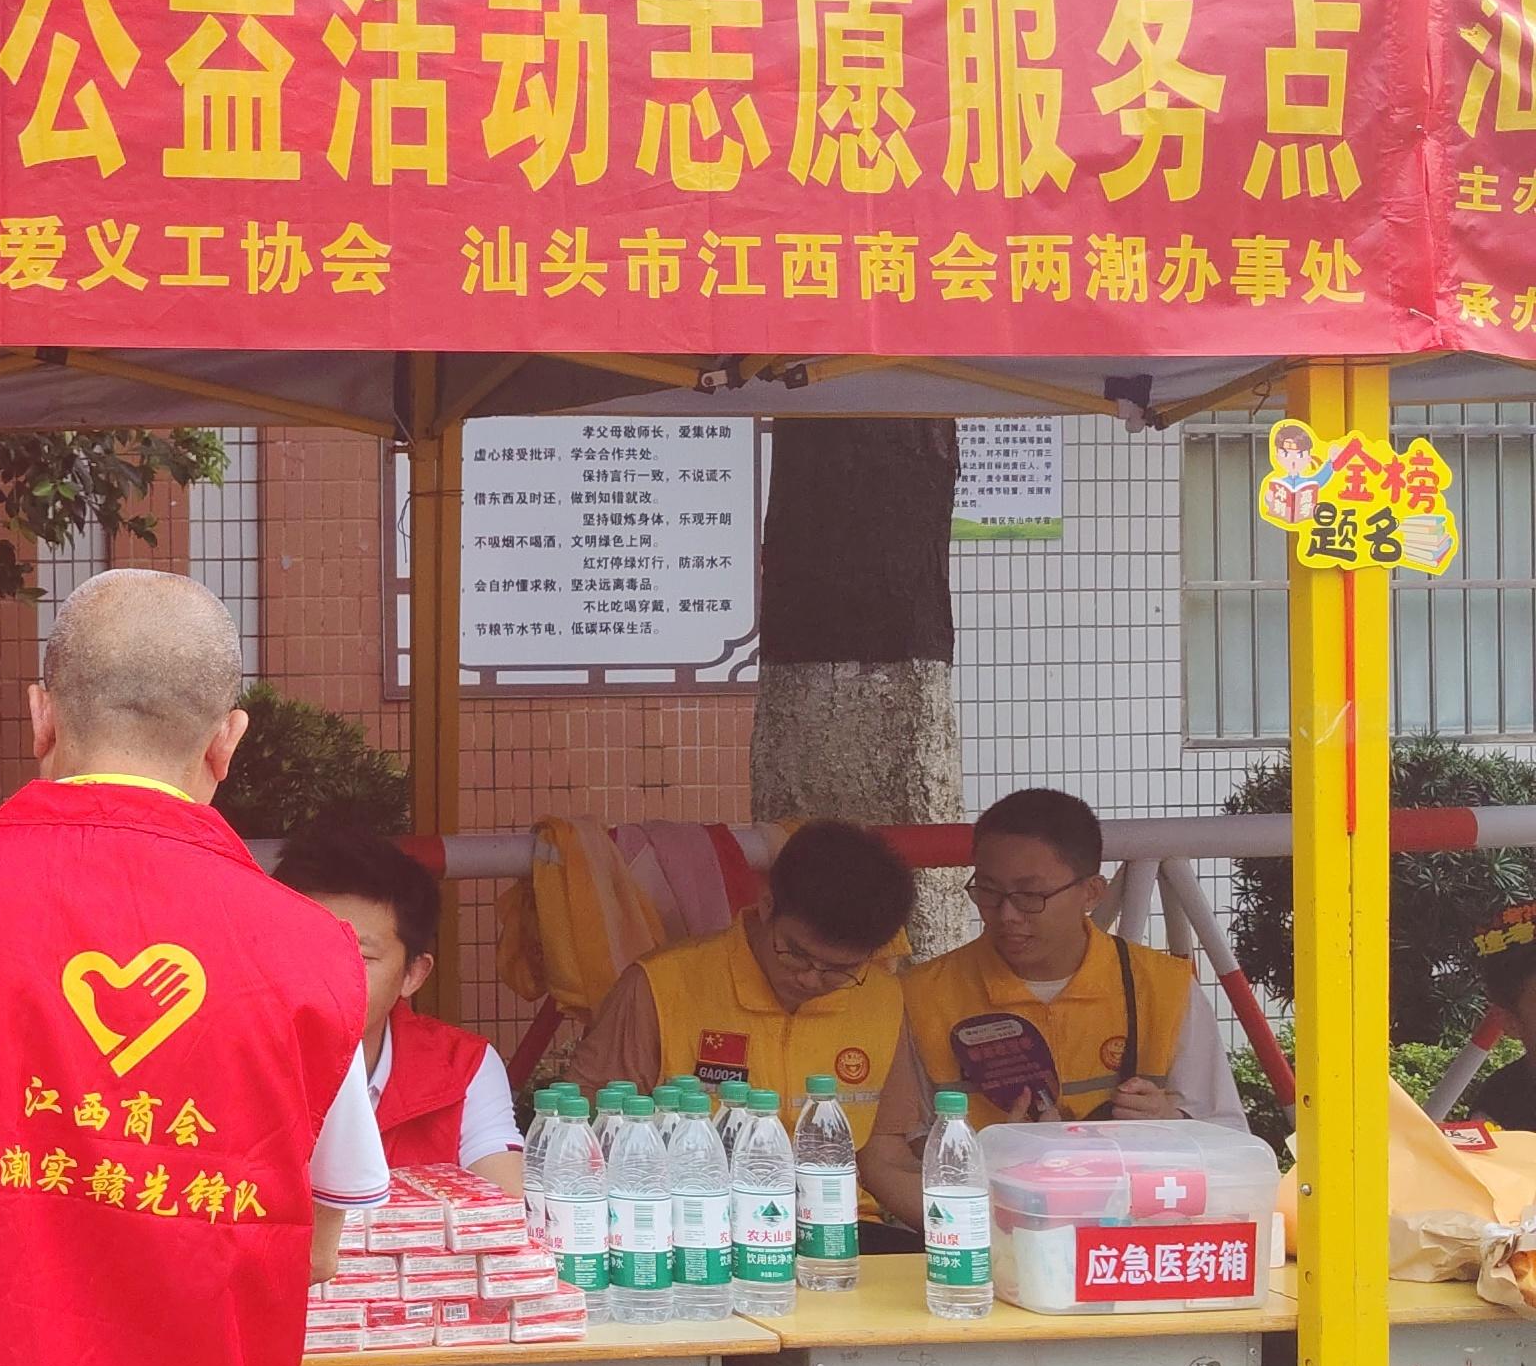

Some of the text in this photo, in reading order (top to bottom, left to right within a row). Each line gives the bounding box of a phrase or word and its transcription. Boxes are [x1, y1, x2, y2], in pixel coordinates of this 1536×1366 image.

[461, 224, 1366, 306] 汕头市江西商会两潮办事处
[1331, 437, 1440, 514] 金榜
[1305, 501, 1403, 563] 题名
[24, 1075, 216, 1147] 江西商会
[1085, 1239, 1249, 1286] 应急医药箱
